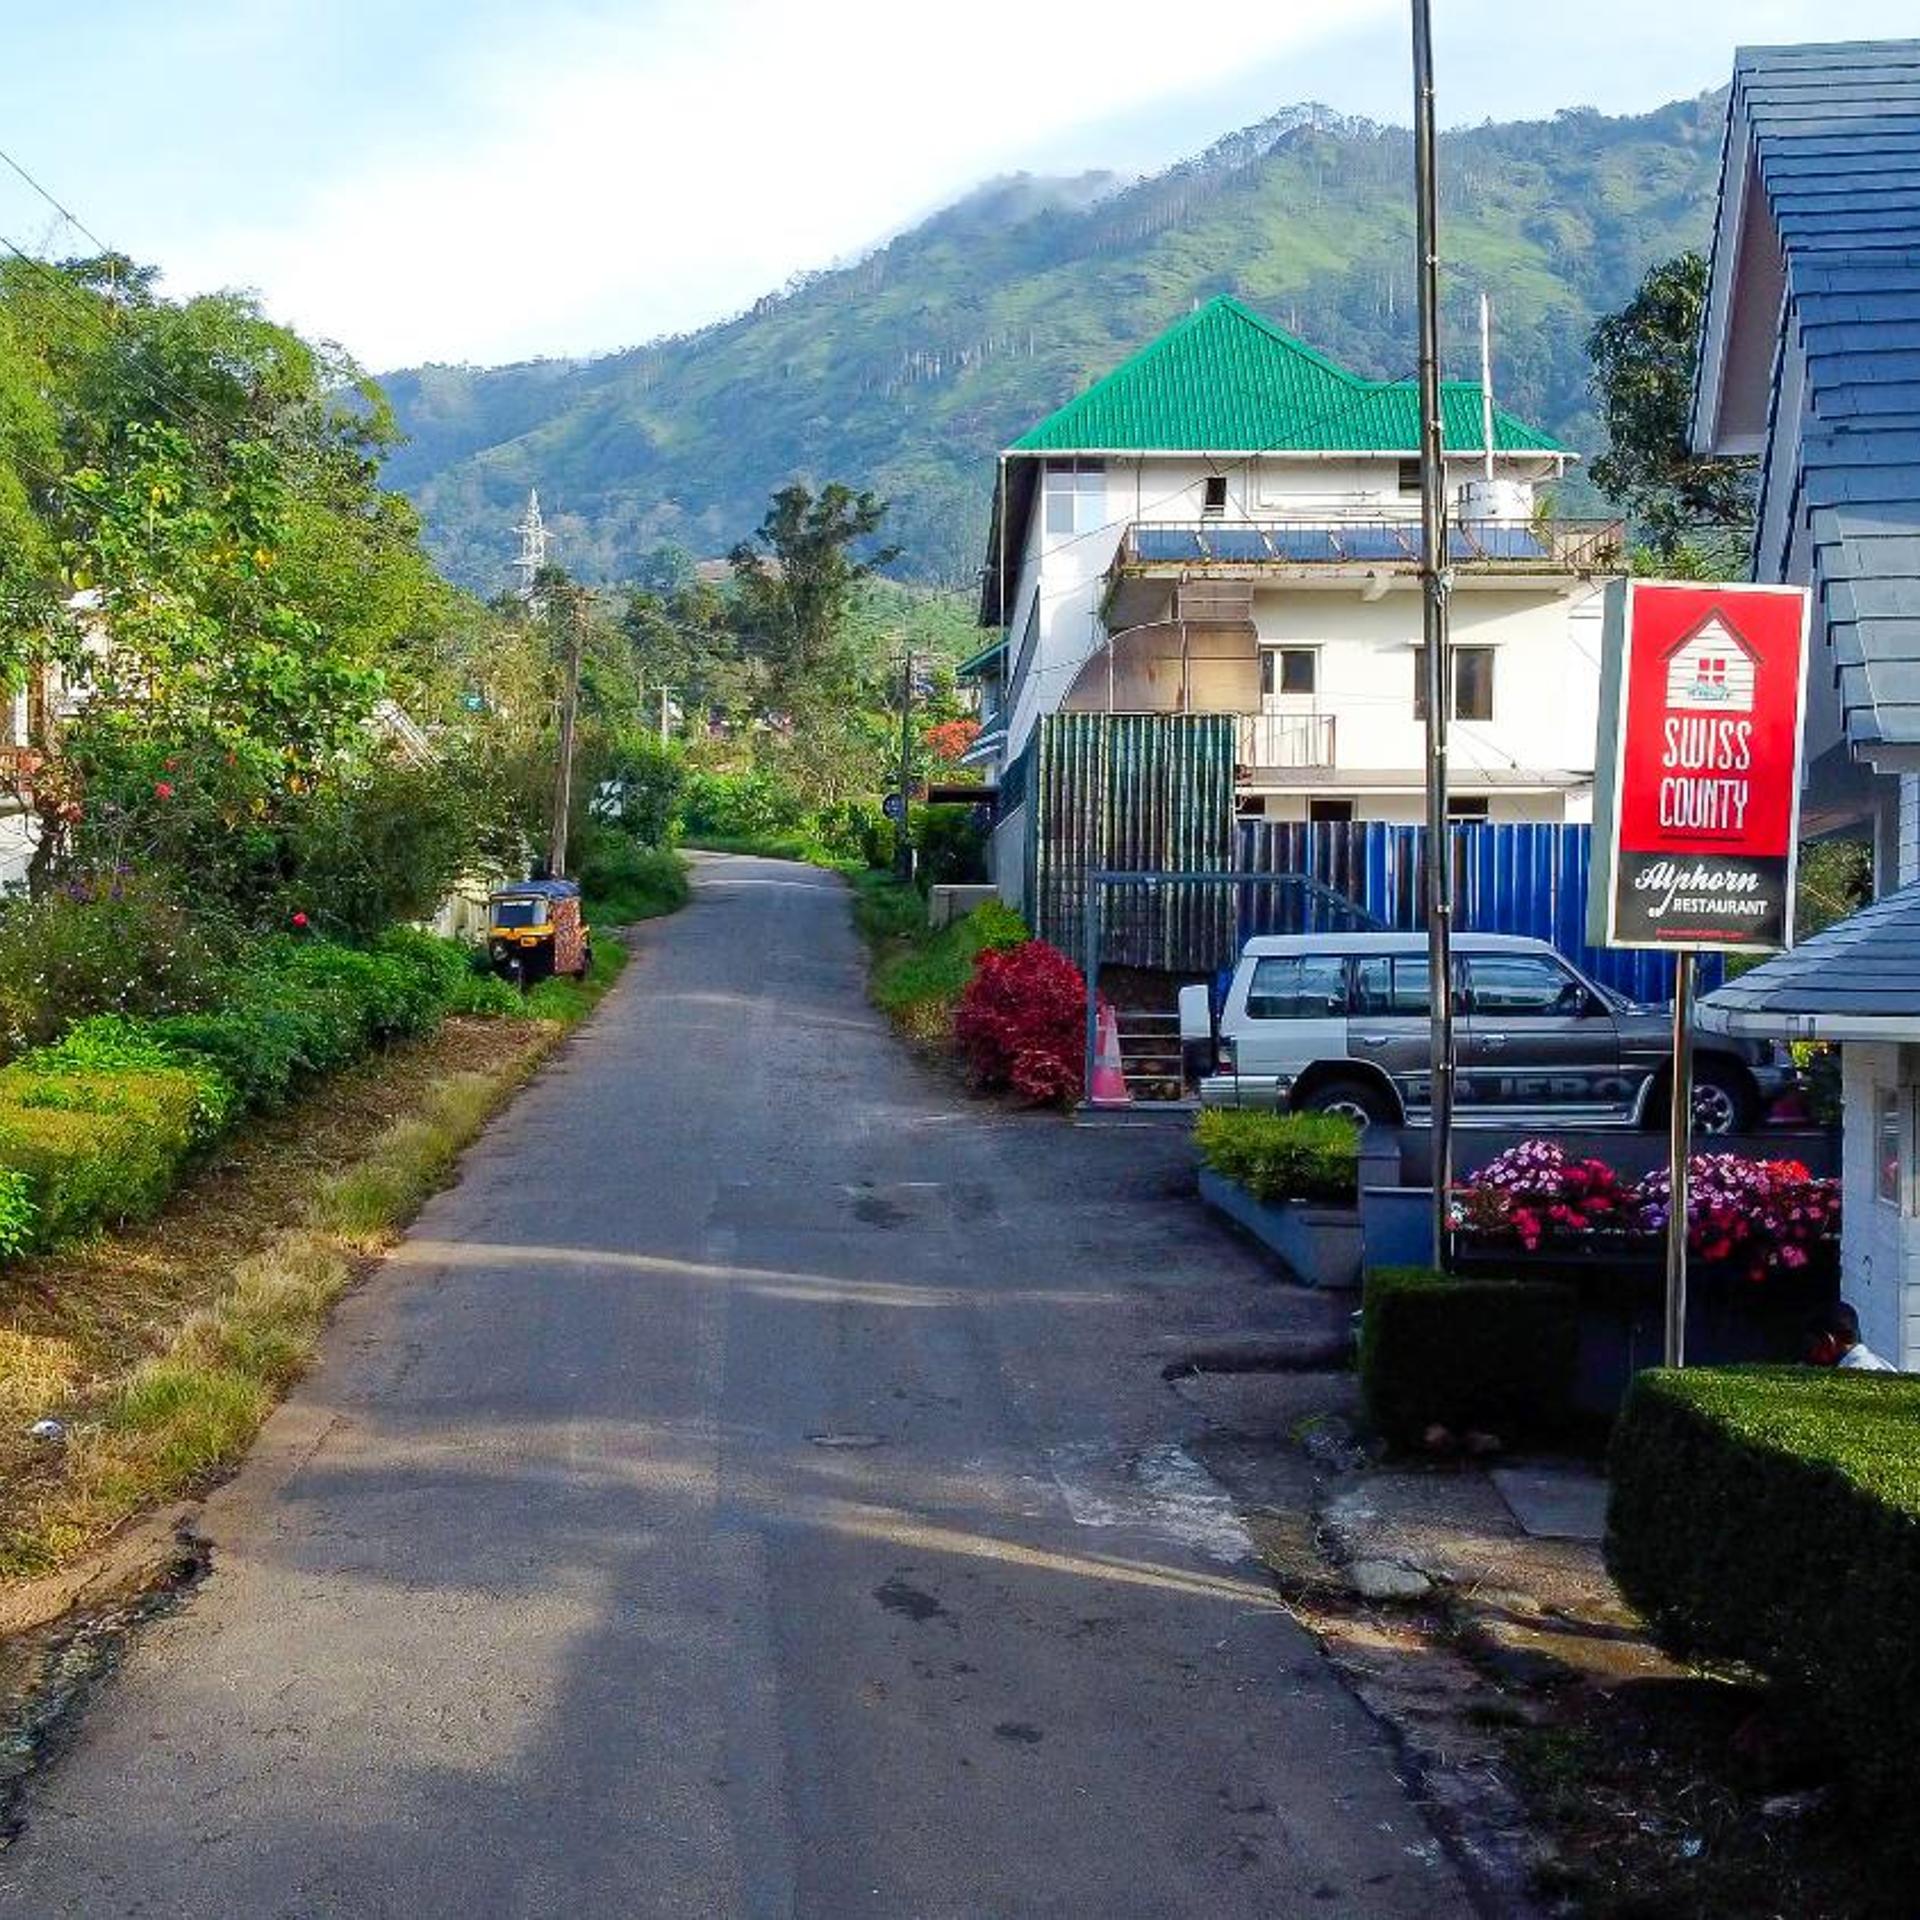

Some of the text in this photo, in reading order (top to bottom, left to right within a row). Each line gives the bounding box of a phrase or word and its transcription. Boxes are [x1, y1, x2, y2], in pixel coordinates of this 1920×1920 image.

[1663, 717, 1752, 770] SWISS
[1660, 777, 1748, 829] COUNTY
[1635, 861, 1760, 917] Alphorn
[1673, 898, 1768, 915] RESTAURANT
